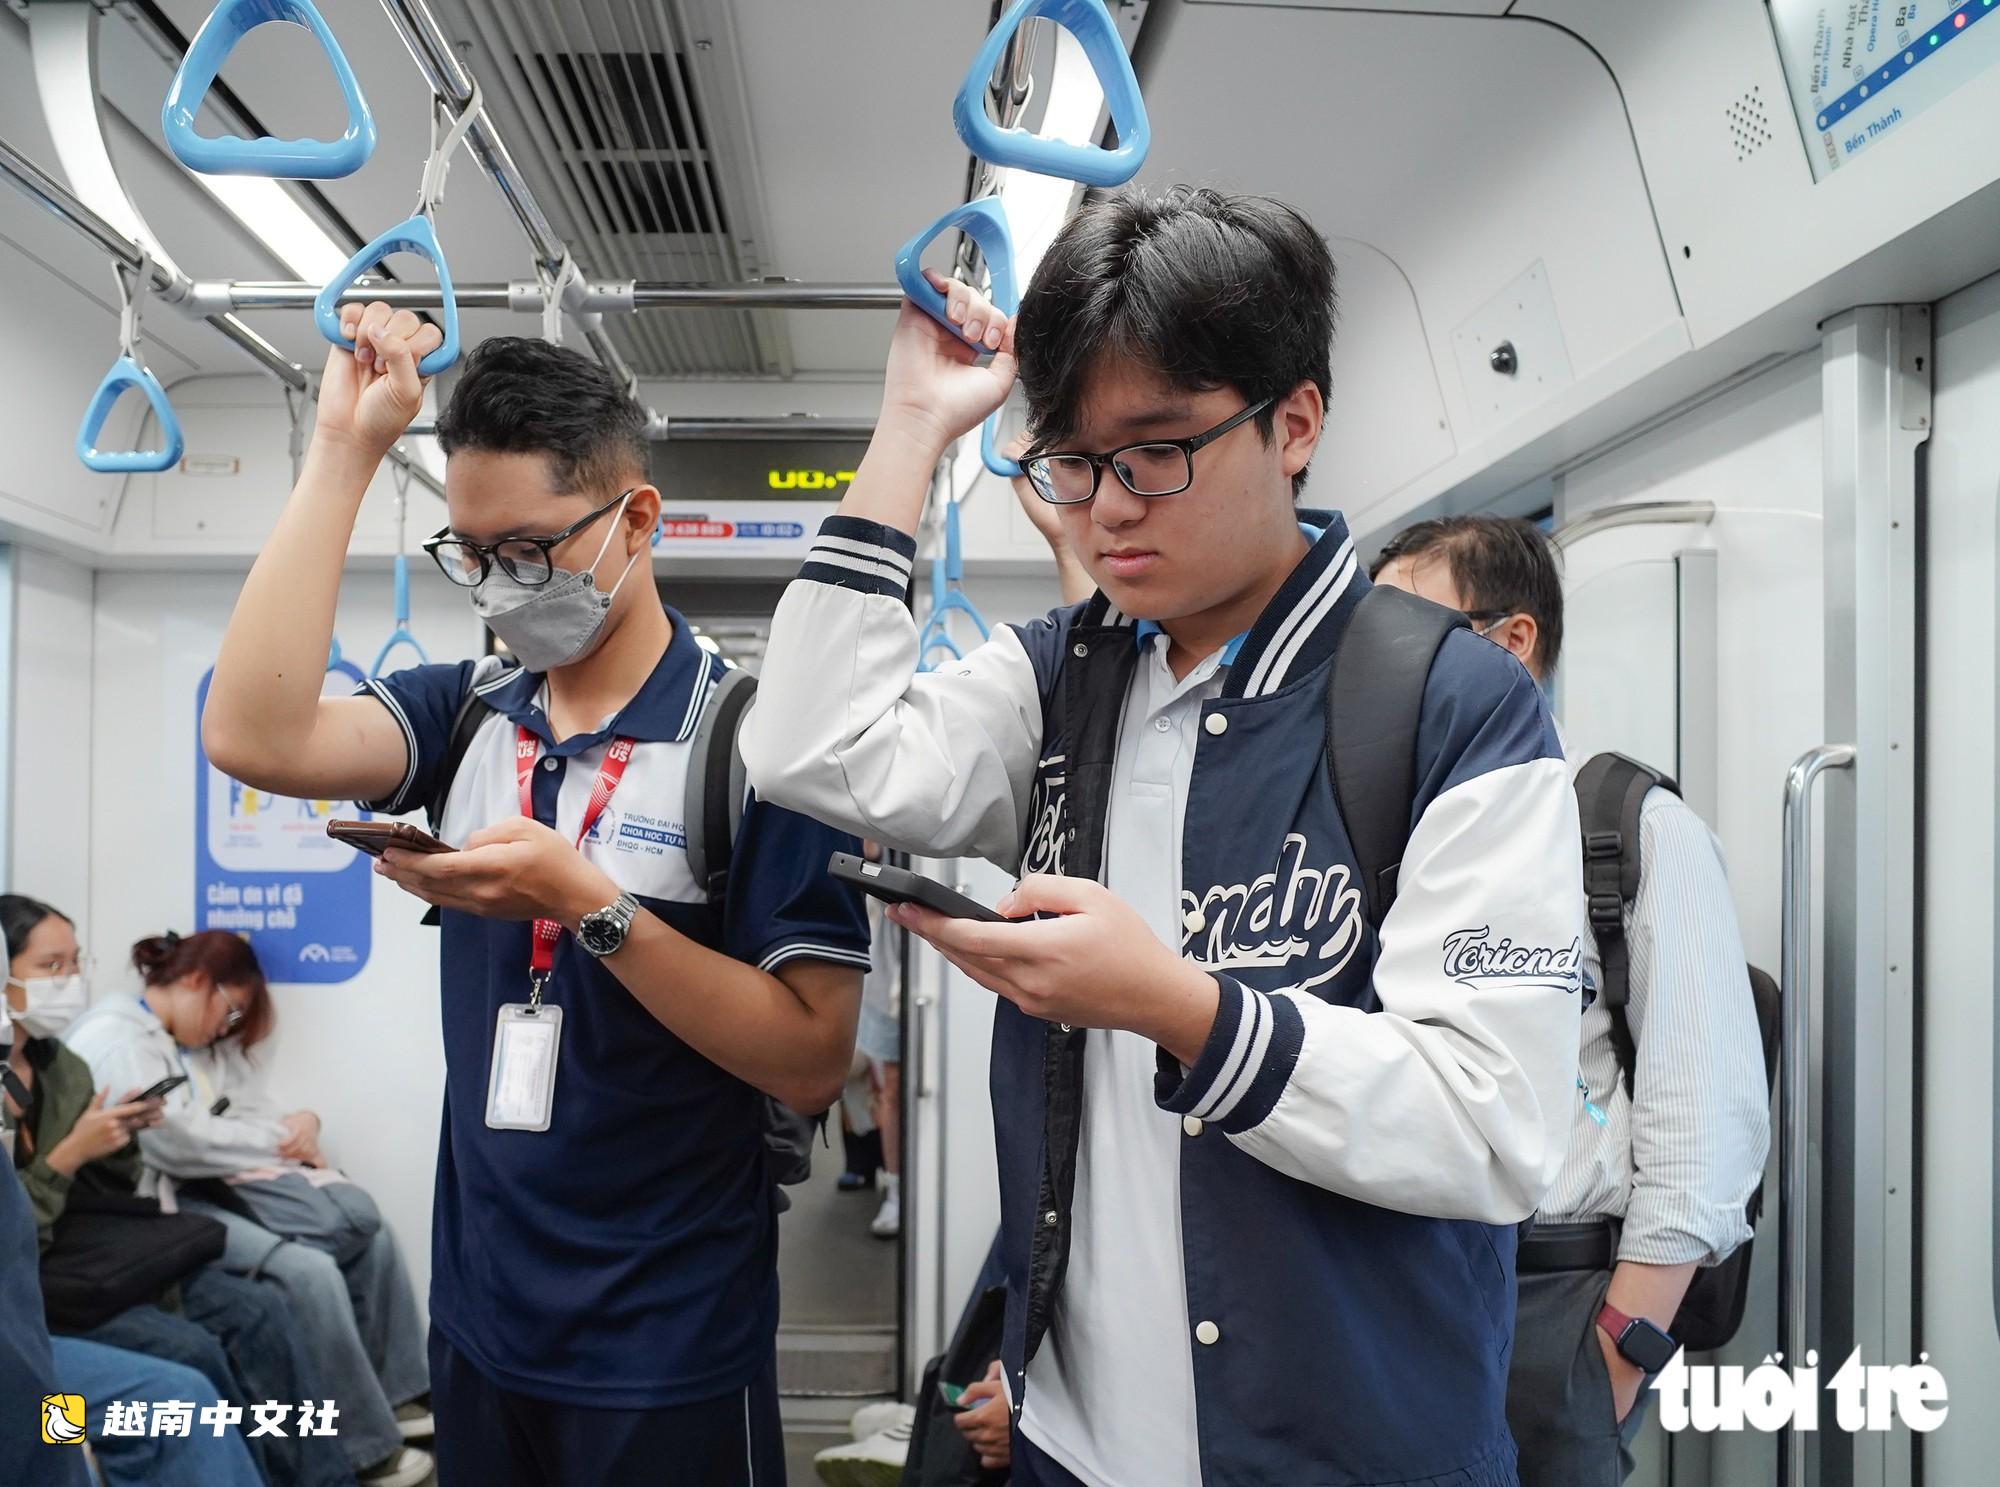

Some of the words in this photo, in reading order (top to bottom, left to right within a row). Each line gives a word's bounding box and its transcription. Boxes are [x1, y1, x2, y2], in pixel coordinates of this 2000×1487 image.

[1895, 6, 1907, 27] Ba
[1844, 133, 1866, 153] Bến
[1866, 107, 1902, 138] Thành
[517, 748, 534, 758] US
[608, 747, 628, 762] US
[621, 824, 643, 837] KHOA
[645, 846, 663, 856] HCM
